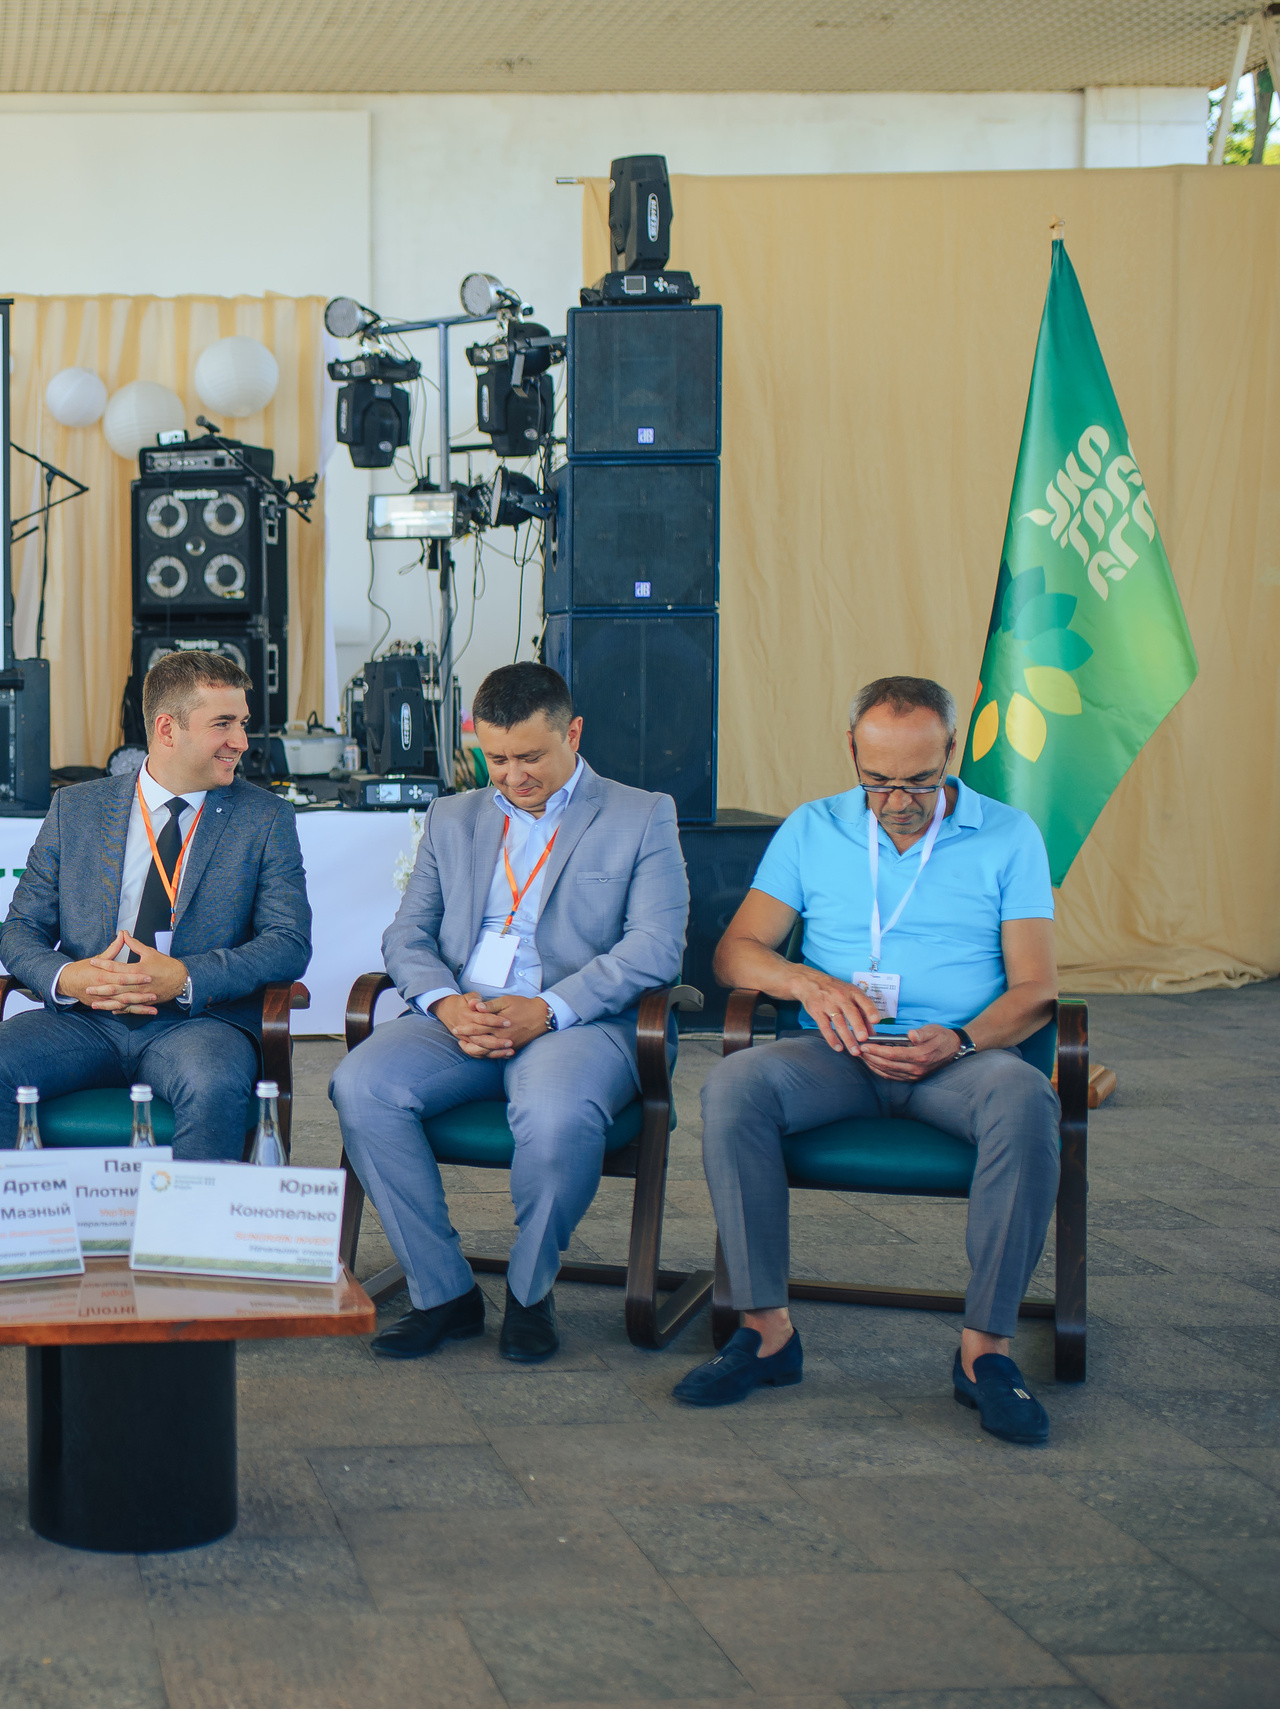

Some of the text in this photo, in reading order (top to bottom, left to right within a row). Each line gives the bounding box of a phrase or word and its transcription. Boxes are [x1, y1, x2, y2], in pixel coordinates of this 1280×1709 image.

[1060, 436, 1144, 567] ТРА
[3, 1178, 69, 1197] Артем
[279, 1177, 340, 1197] Юрий
[0, 1202, 72, 1222] Мазный
[229, 1202, 338, 1223] Конопелько
